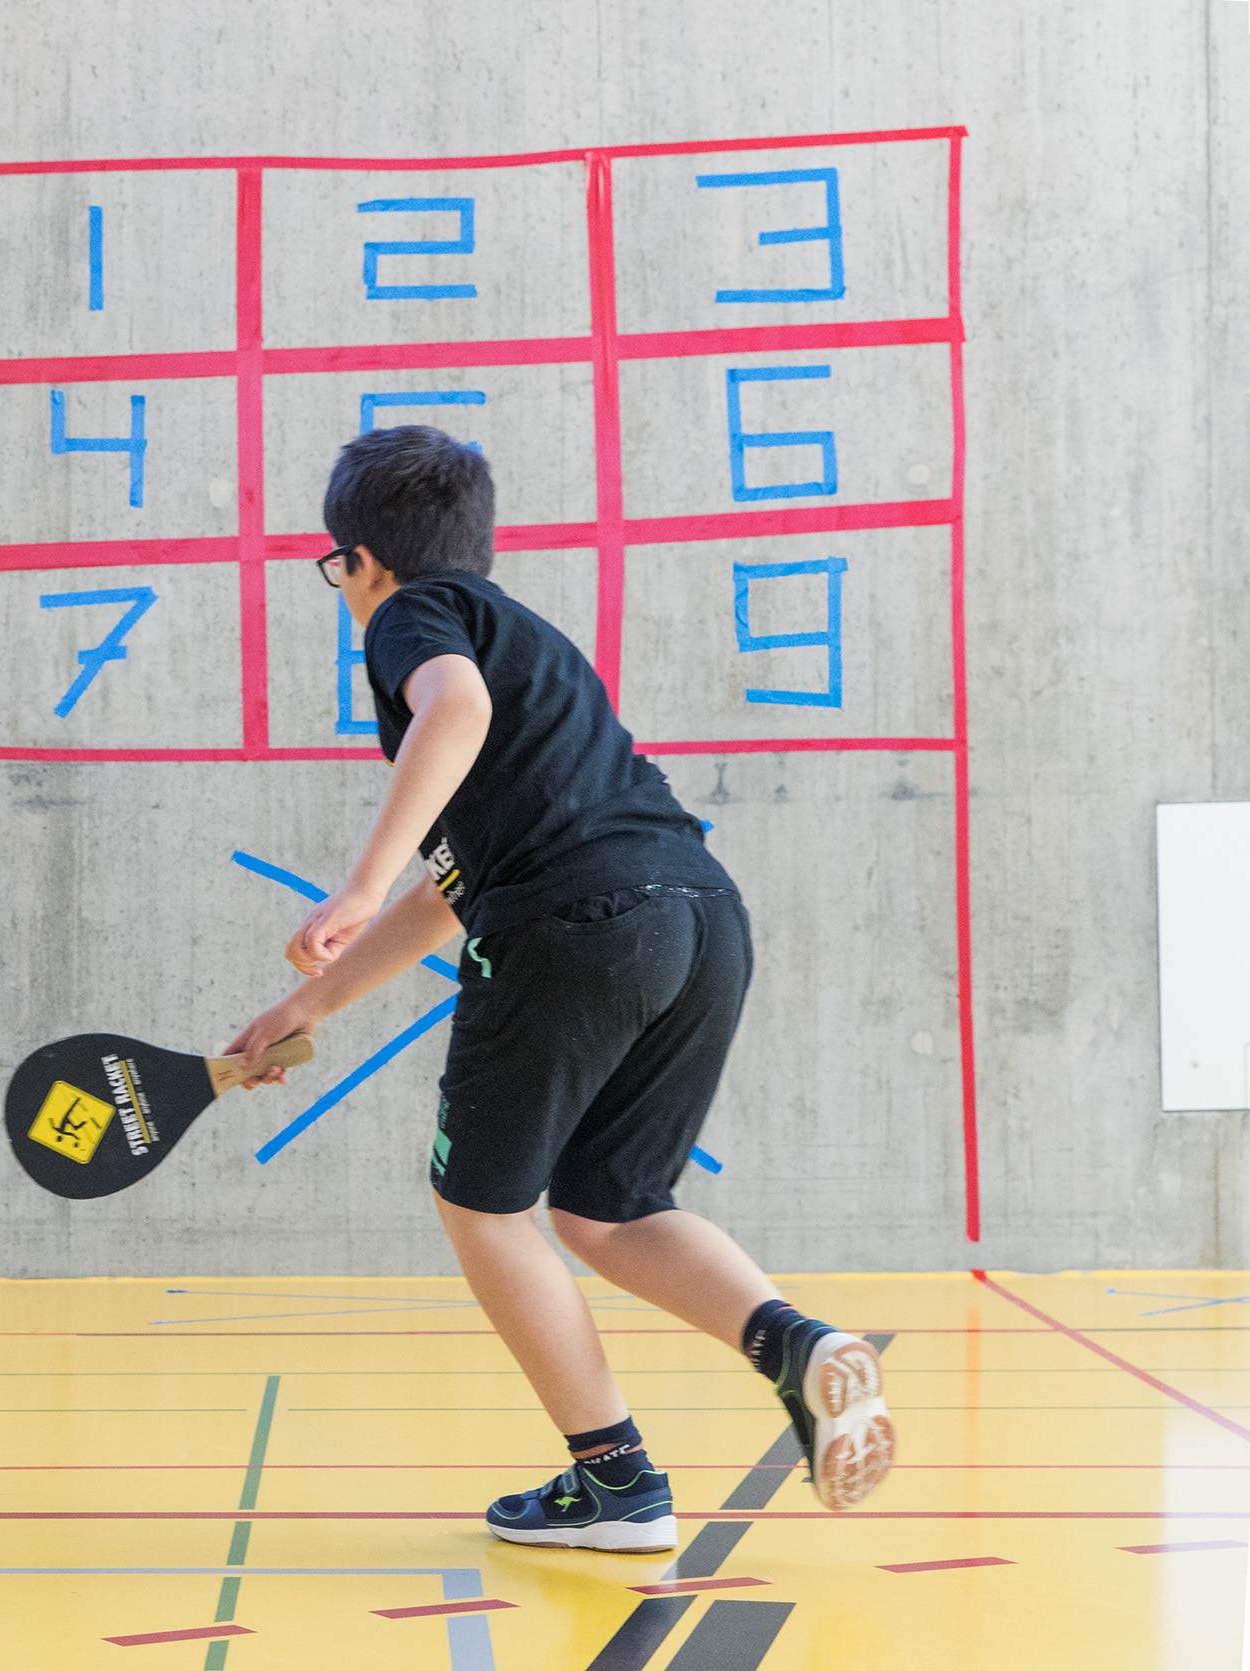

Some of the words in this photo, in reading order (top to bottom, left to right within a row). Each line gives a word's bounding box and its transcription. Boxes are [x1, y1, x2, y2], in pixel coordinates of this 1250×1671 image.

[88, 205, 105, 312] 1
[356, 196, 478, 301] 2
[695, 166, 846, 304] 3
[50, 389, 149, 509] 4
[724, 364, 839, 503] 6
[39, 585, 159, 719] 7
[732, 555, 849, 709] 9
[101, 1053, 133, 1105] RACKET
[118, 1108, 150, 1156] STREET
